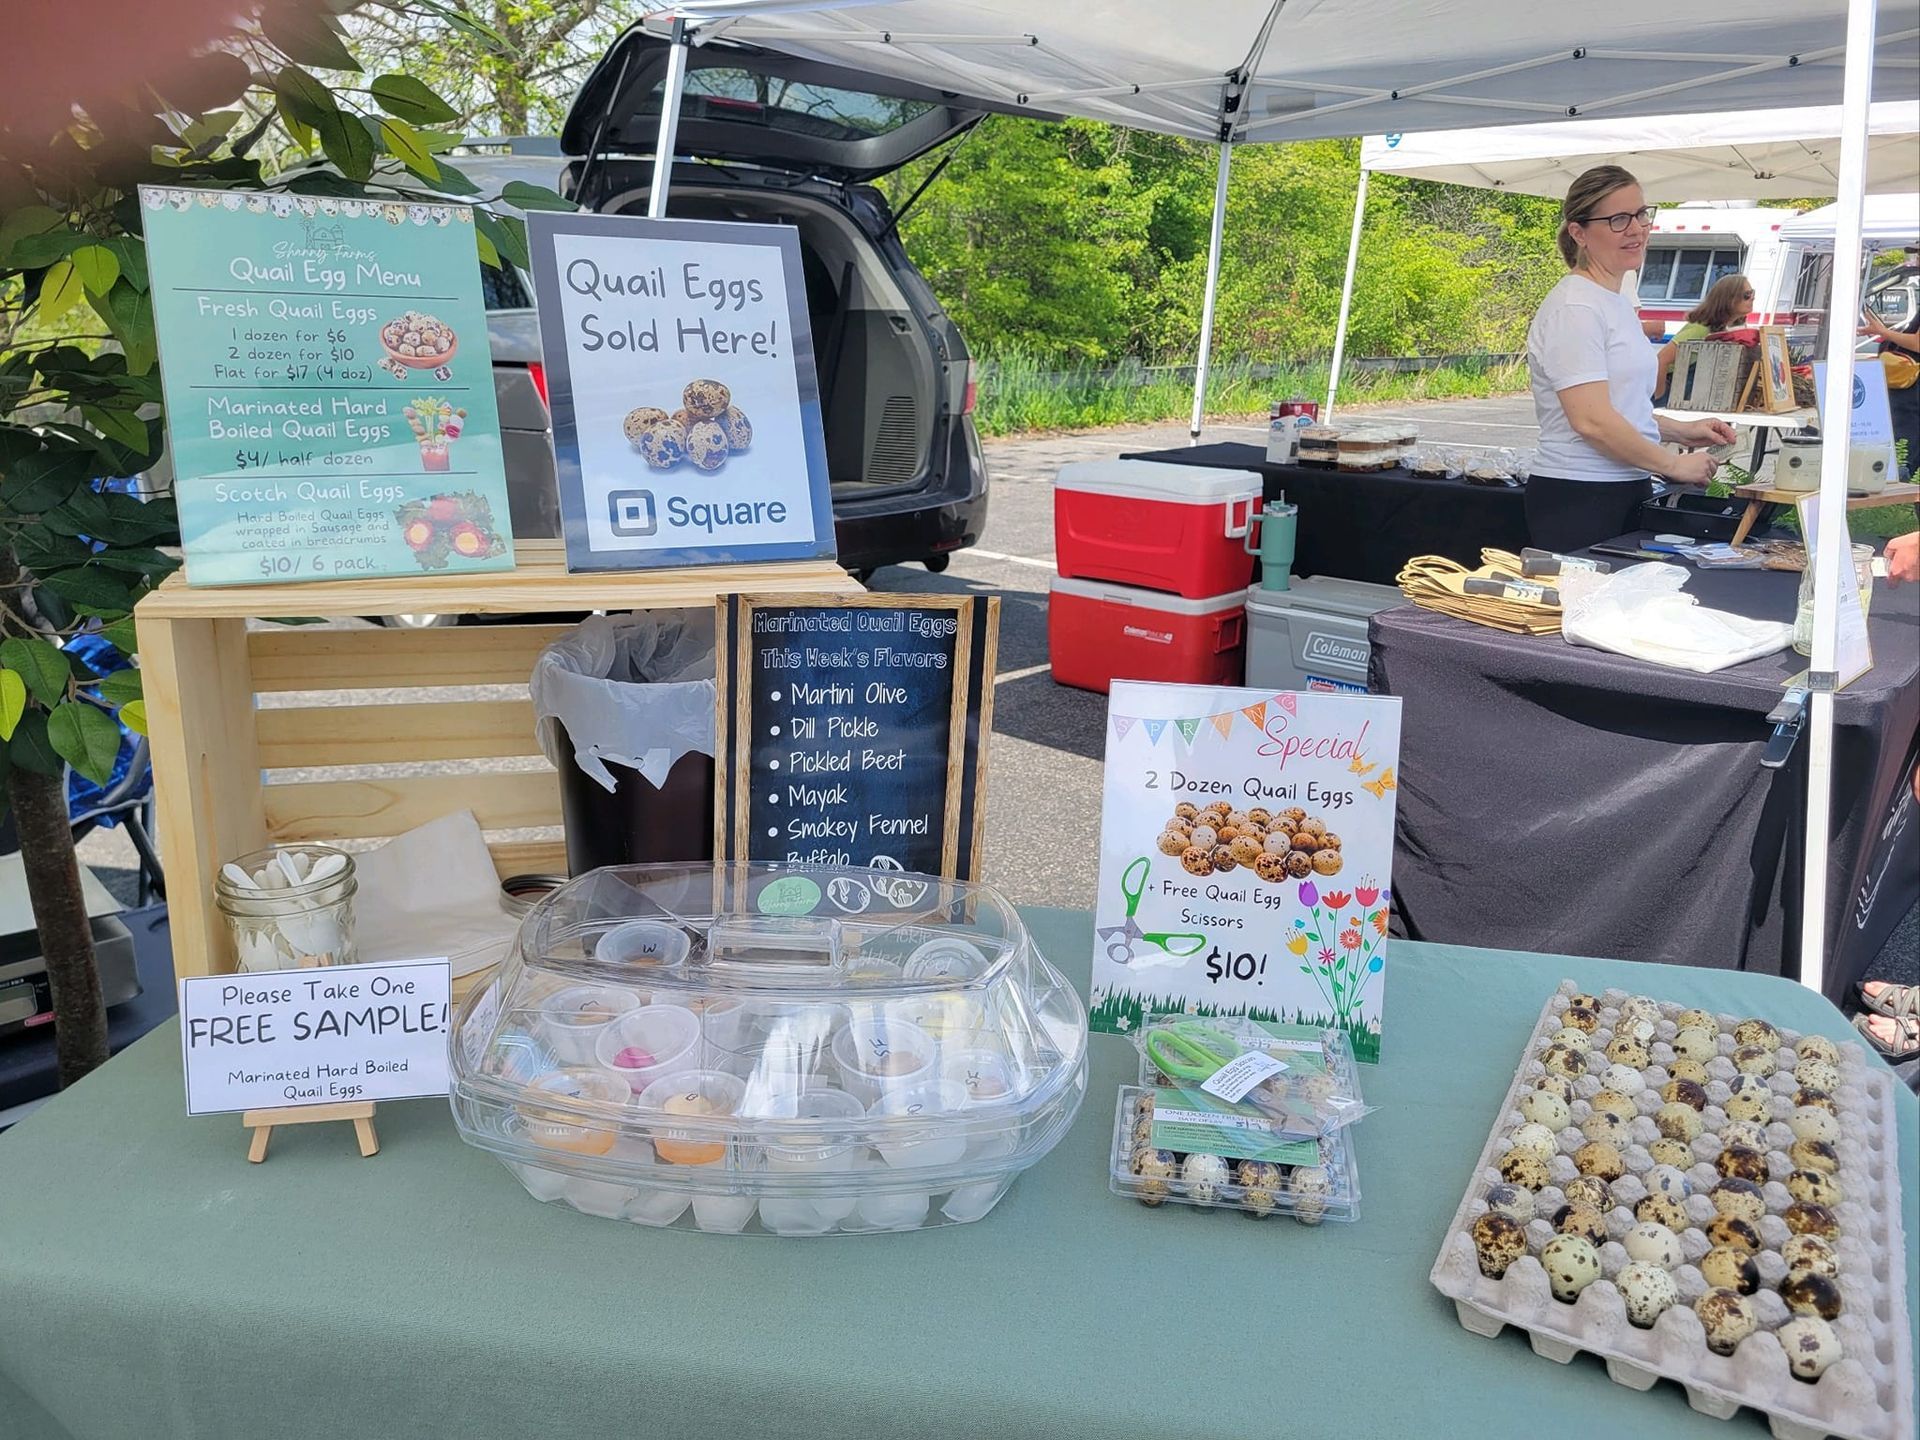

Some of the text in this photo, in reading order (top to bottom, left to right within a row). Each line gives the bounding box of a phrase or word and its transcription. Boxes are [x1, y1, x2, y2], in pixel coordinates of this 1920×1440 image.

[230, 257, 421, 290] Quail Egg Menu
[566, 258, 764, 311] Quail Eggs
[197, 297, 378, 325] Fresh Quail Eggs
[232, 328, 346, 345] 1 dozen for $6
[580, 314, 777, 358] Sold Here!
[228, 347, 354, 363] 2 dozen for $10
[214, 365, 373, 382] Flat for $17 (4 doz)
[207, 396, 388, 416] Marinated Hard
[209, 419, 391, 443] Boiled Quail Eggs
[235, 449, 373, 470] $4/ half dozen
[215, 481, 405, 503] Scotch Quail Eggs
[237, 508, 384, 523] Hard Boiled Quail Eggs
[667, 497, 787, 533] Square
[236, 521, 390, 537] wrapped in Sausage and
[242, 535, 386, 549] coated in breadcrumbs
[260, 555, 301, 576] $10/
[312, 555, 324, 571] 6
[754, 611, 957, 638] Marinated Quail Eggs
[761, 648, 801, 668] This
[874, 648, 947, 669] Flavors
[1313, 637, 1367, 662] Coleman
[791, 682, 908, 705] Martini Olive
[791, 716, 879, 739] Dill Pickle
[1257, 715, 1371, 770] Special
[789, 749, 906, 773] Pickled Beet
[789, 783, 848, 813] Mayak
[1145, 771, 1354, 809] 2 Dozen Quail Eggs
[787, 814, 928, 843] Smokey Fennel
[1163, 880, 1198, 898] Free
[1205, 885, 1246, 903] Quail
[1254, 889, 1281, 910] Egg
[1180, 909, 1244, 929] Scissors
[1206, 946, 1267, 985] $10!
[222, 977, 415, 1006] Please Take One
[189, 1014, 276, 1048] FREE
[293, 1003, 448, 1040] SAMPLE!
[228, 1059, 409, 1085] Marinated Hard Boiled
[283, 1083, 363, 1101] Quail Eggs
